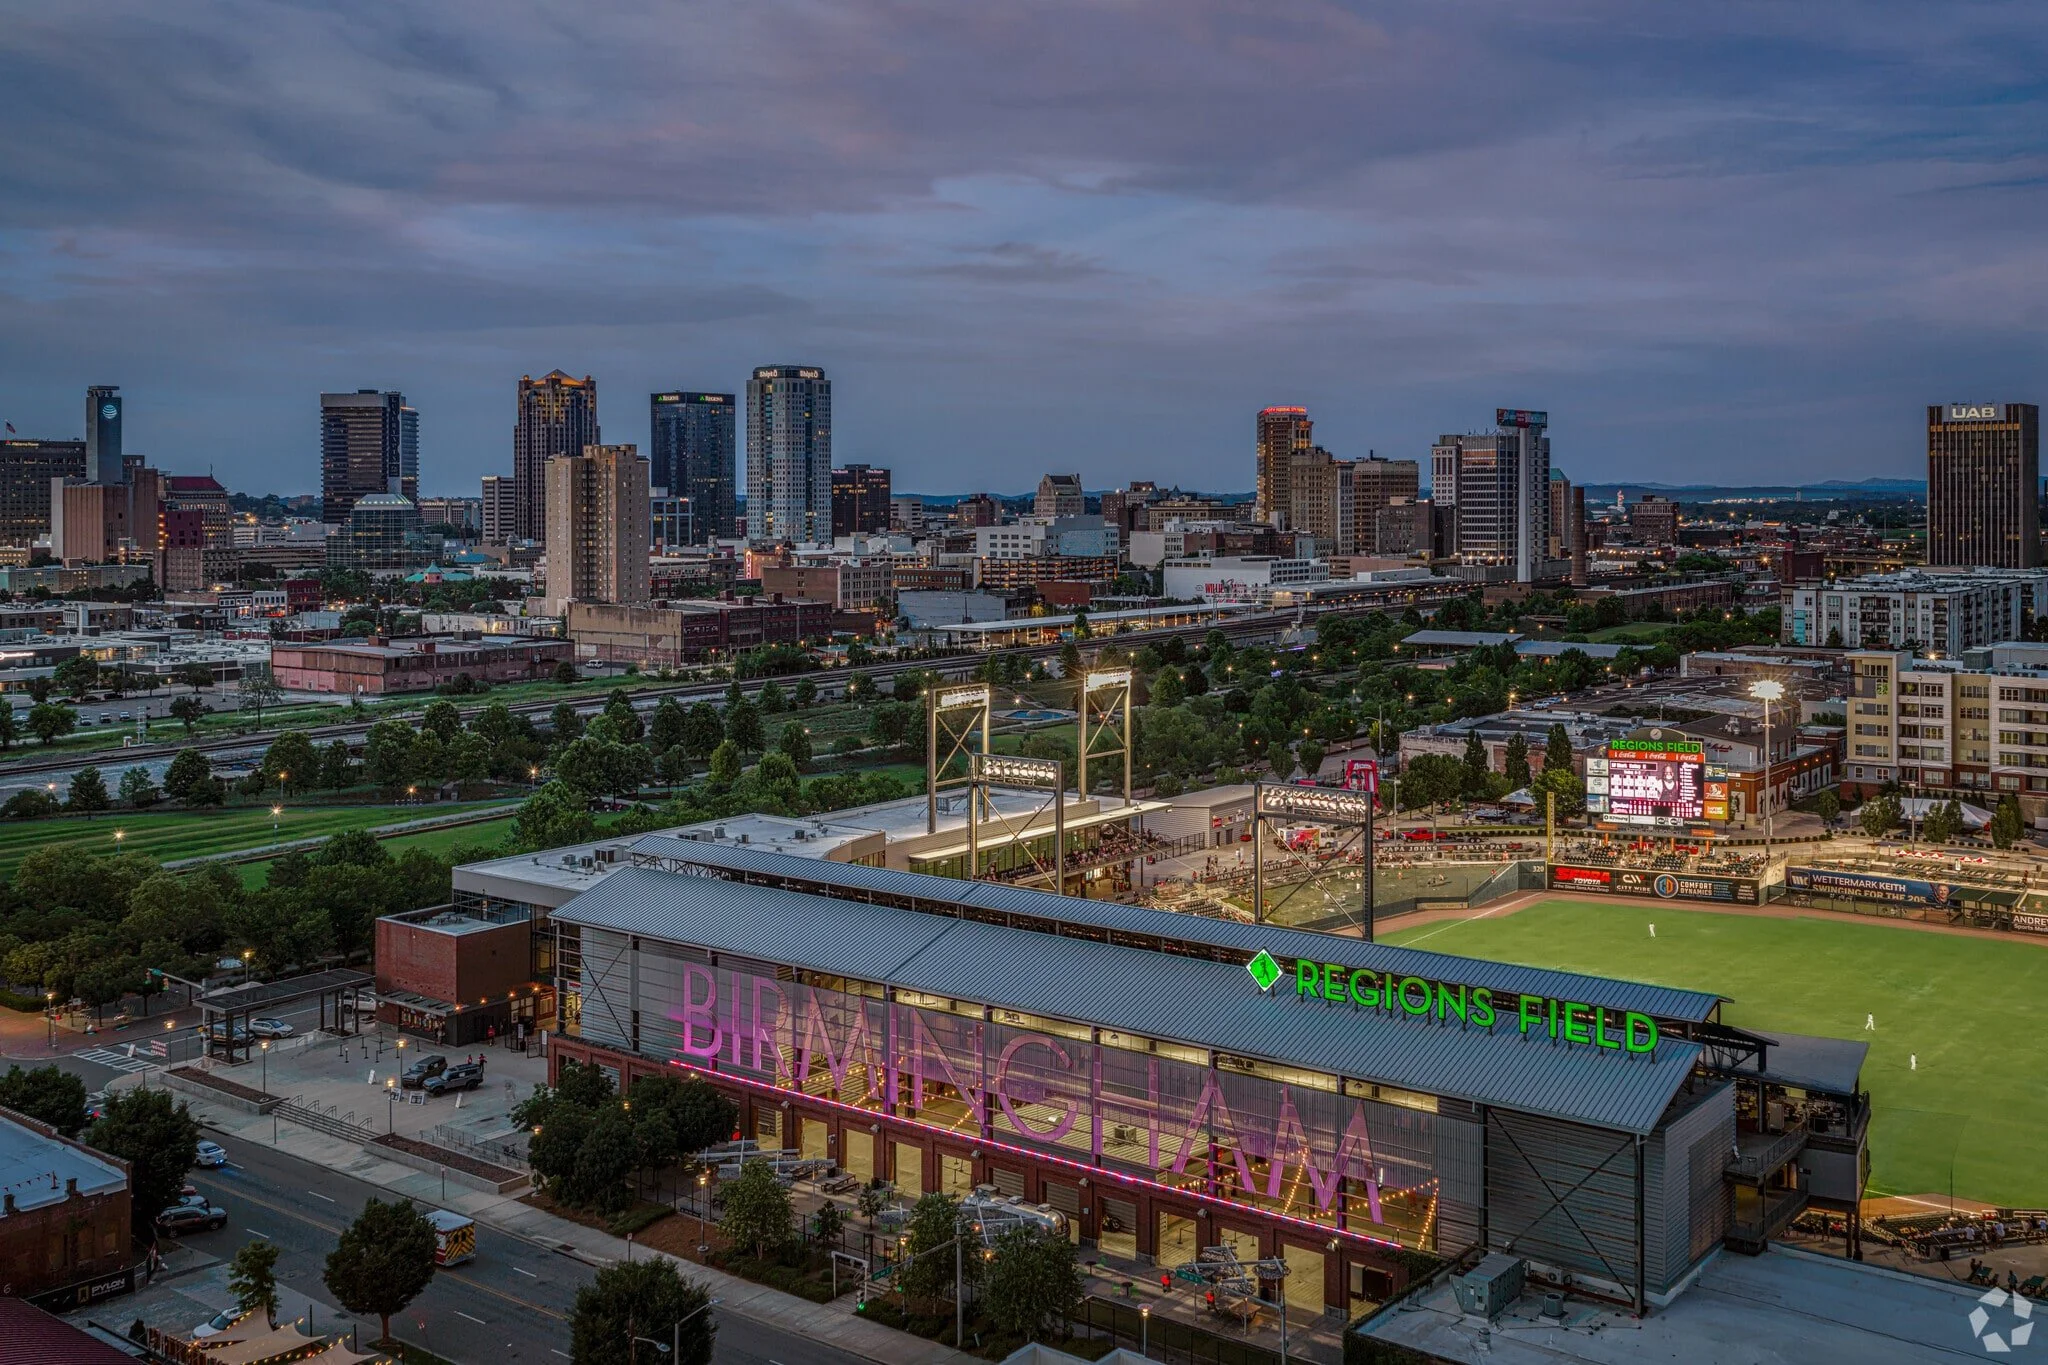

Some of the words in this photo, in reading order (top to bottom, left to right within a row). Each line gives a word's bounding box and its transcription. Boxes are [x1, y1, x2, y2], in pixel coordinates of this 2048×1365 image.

[1952, 407, 1995, 418] UAB
[1611, 740, 1663, 752] REGIONS
[1667, 742, 1699, 753] FIELD
[1554, 867, 1611, 883] SERRA
[1812, 874, 1877, 889] WETTERMARK
[1879, 882, 1906, 892] KEITH
[1680, 881, 1713, 889] COMFORT
[1680, 888, 1713, 896] DYNAMICS
[1812, 884, 1862, 896] SWINGING
[1864, 889, 1883, 898] FOR
[1886, 892, 1905, 901] THE
[1907, 894, 1927, 903] 205
[2013, 915, 2048, 926] ANDRE
[1296, 958, 1497, 1027] REGIONS
[1519, 993, 1658, 1053] FIELD
[682, 962, 1383, 1225] BIRMINGHAM
[91, 1278, 125, 1294] PYLON
